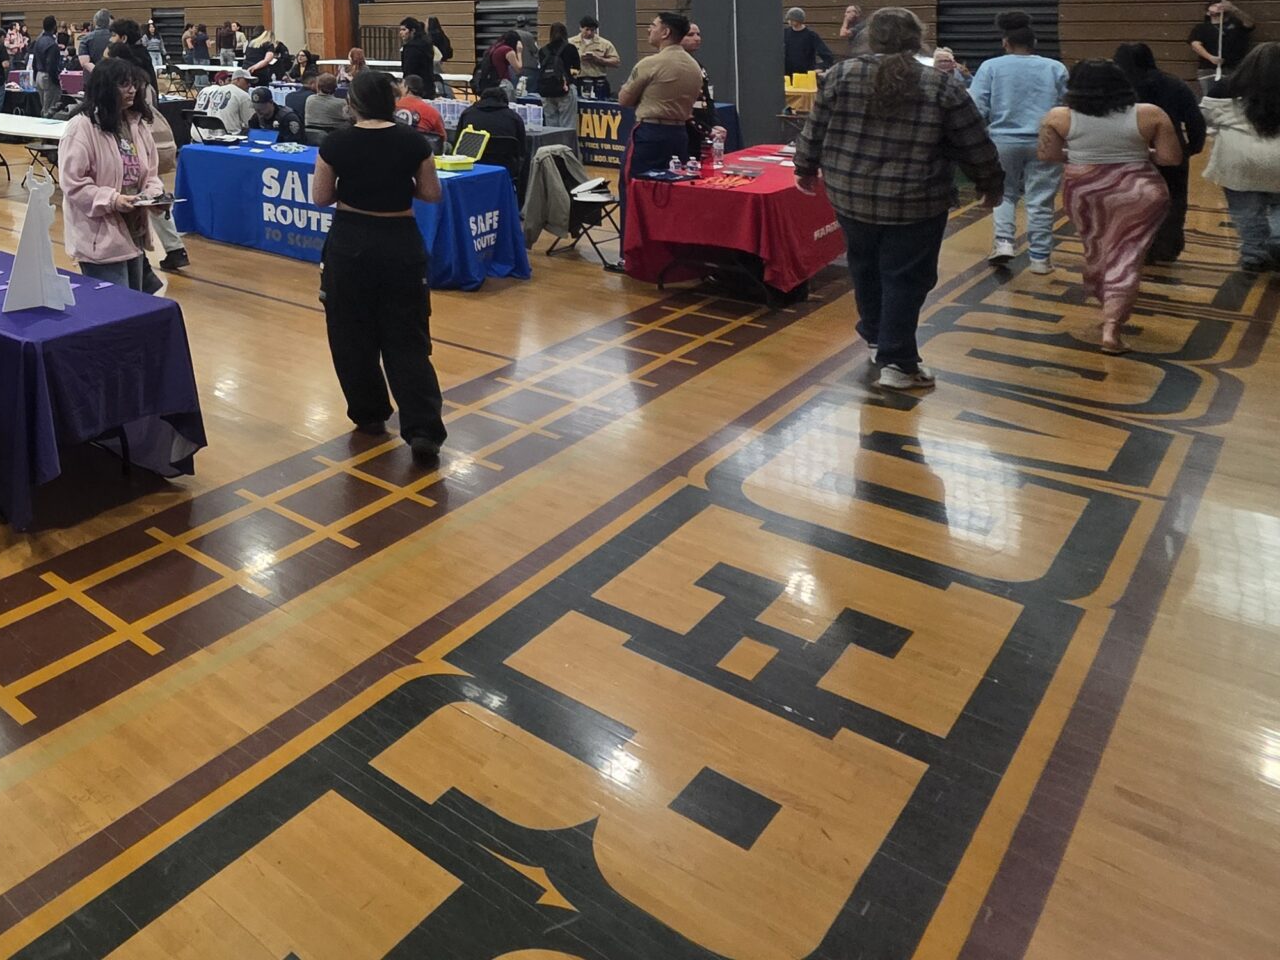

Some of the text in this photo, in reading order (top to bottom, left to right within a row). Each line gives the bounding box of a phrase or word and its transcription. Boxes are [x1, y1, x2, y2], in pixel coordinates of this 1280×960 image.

[577, 110, 622, 140] AVY
[262, 202, 333, 233] ROUTE
[469, 210, 499, 237] SAFE
